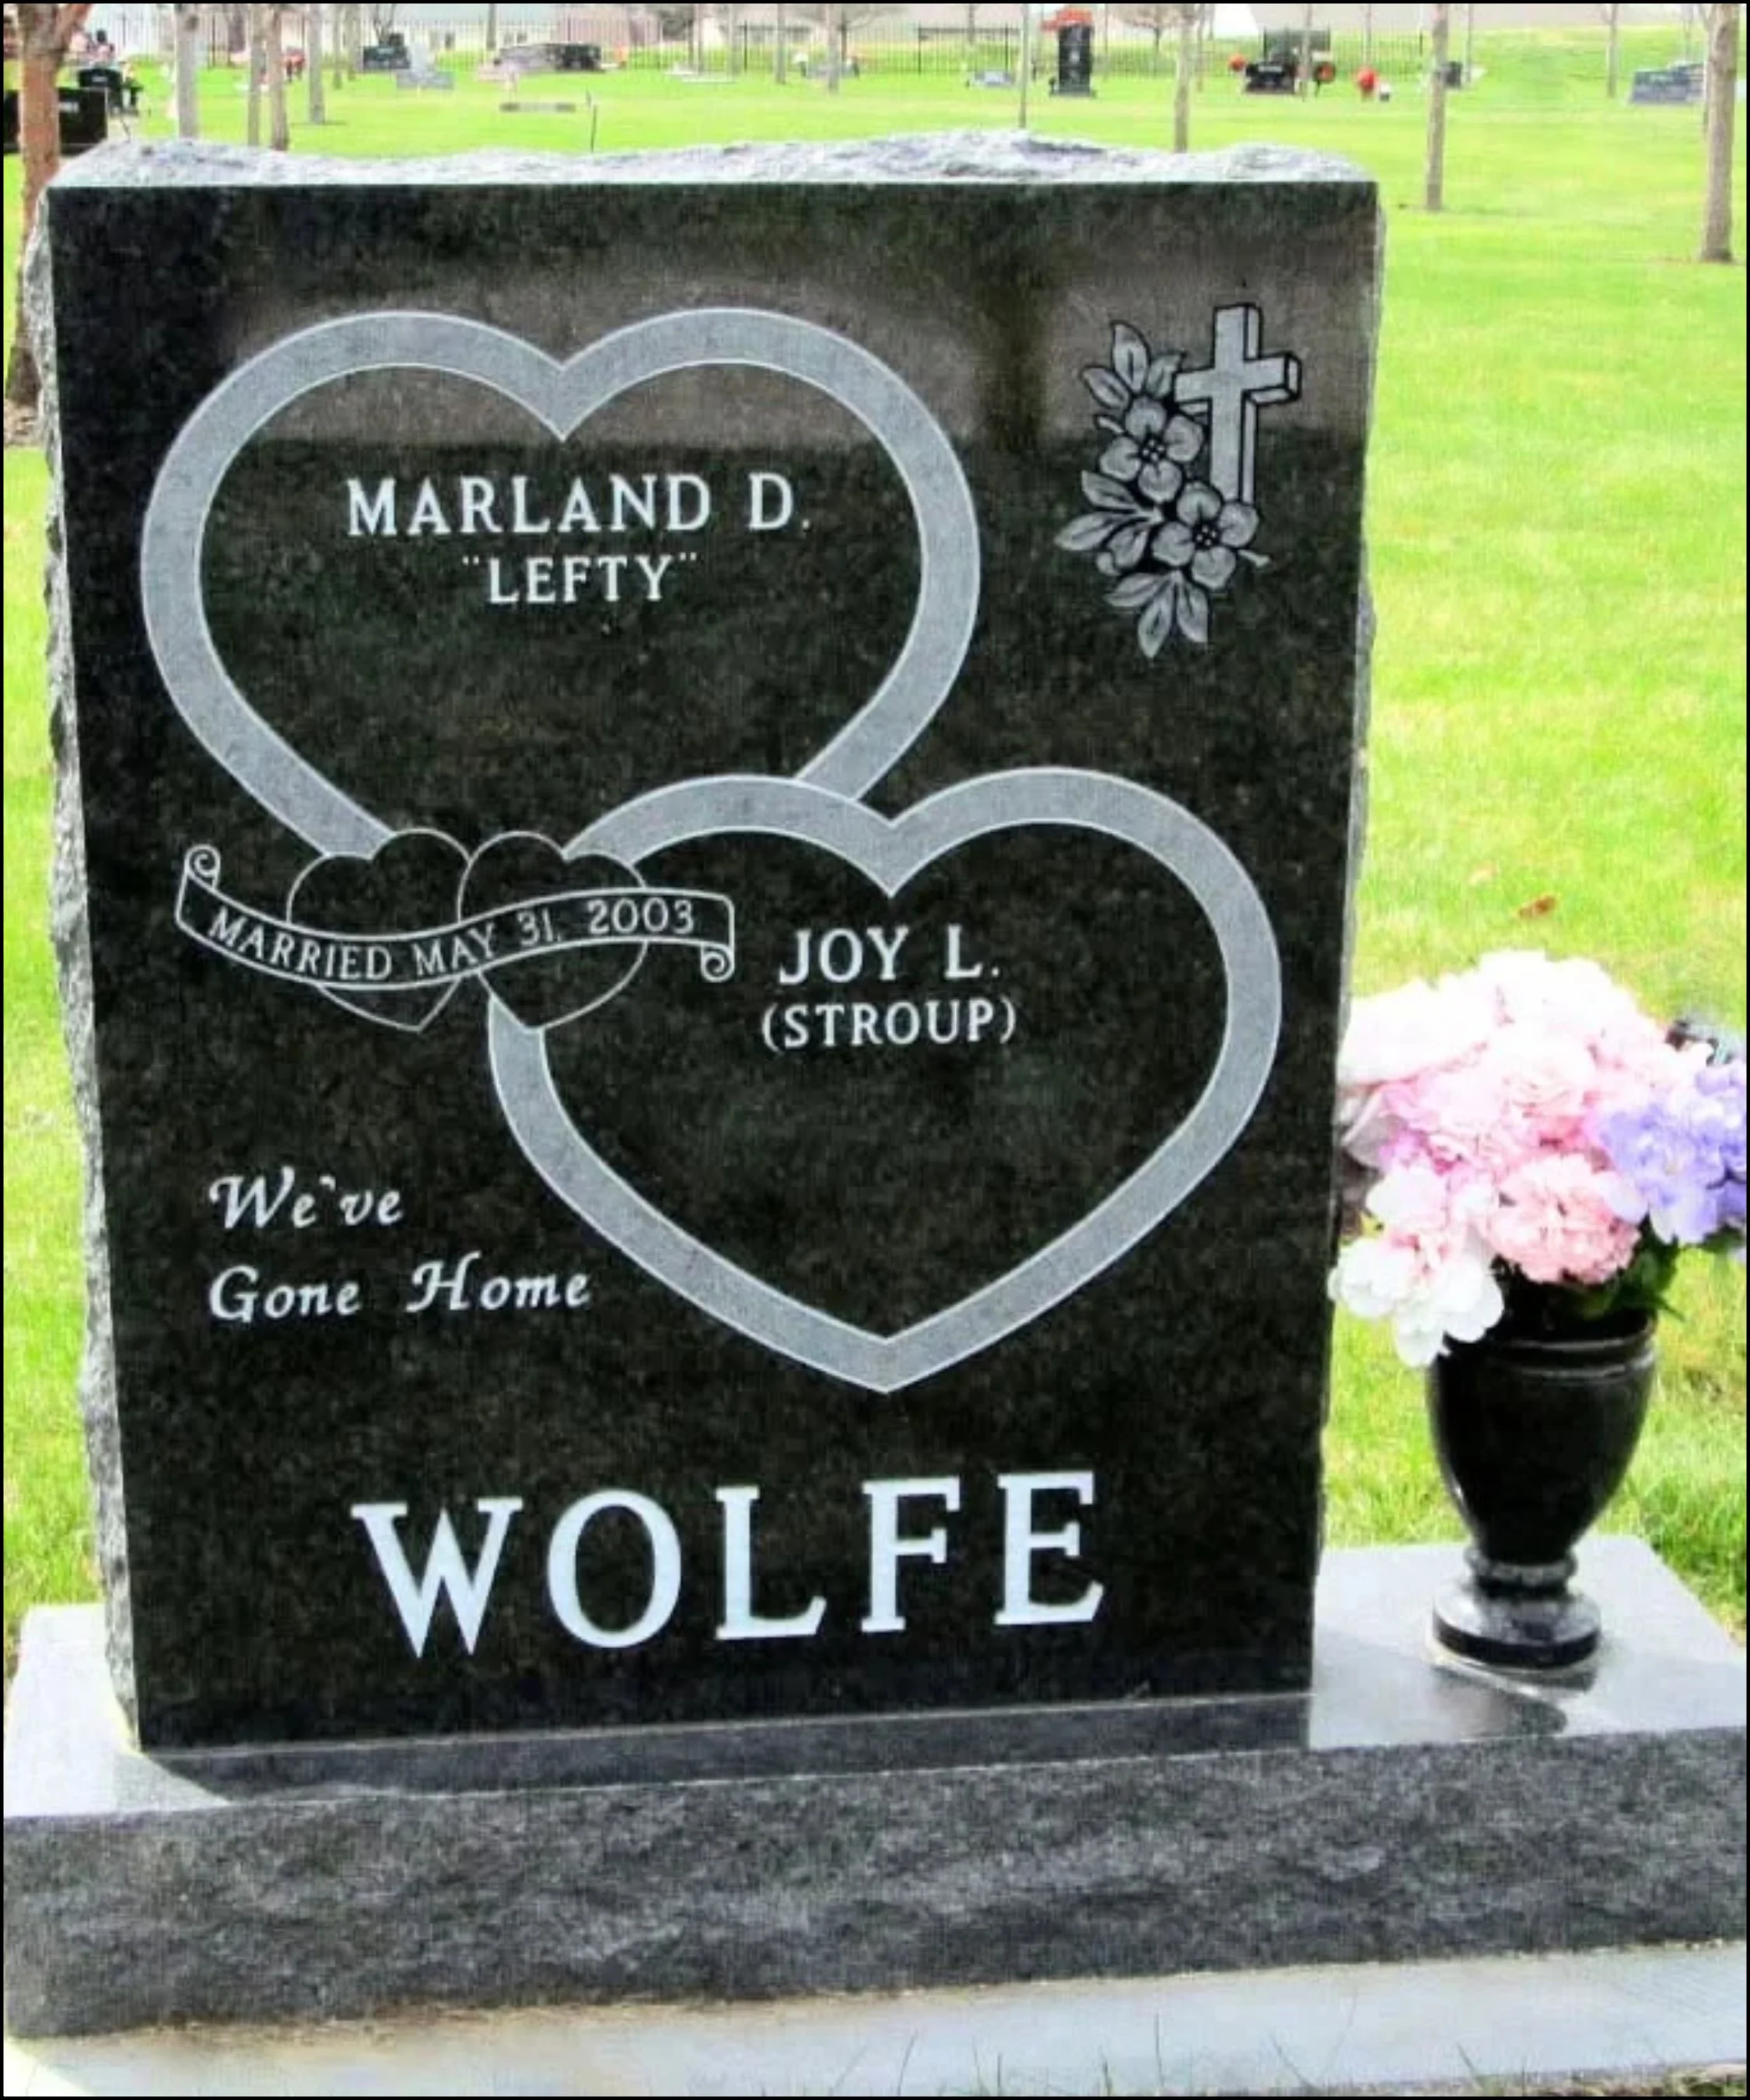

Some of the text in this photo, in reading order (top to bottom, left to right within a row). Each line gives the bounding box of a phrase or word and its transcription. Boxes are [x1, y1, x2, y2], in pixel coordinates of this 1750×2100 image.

[347, 472, 810, 536] MARLAND D.
[462, 551, 698, 604] "LEFTY"
[208, 905, 393, 981] MARRIED
[412, 922, 496, 976] MAY
[586, 897, 695, 934] 2003
[779, 922, 1001, 985] JOY L.
[761, 996, 1017, 1054] (STROUP)
[208, 1251, 591, 1322] Gone Home
[350, 1470, 1104, 1659] WOLFE
